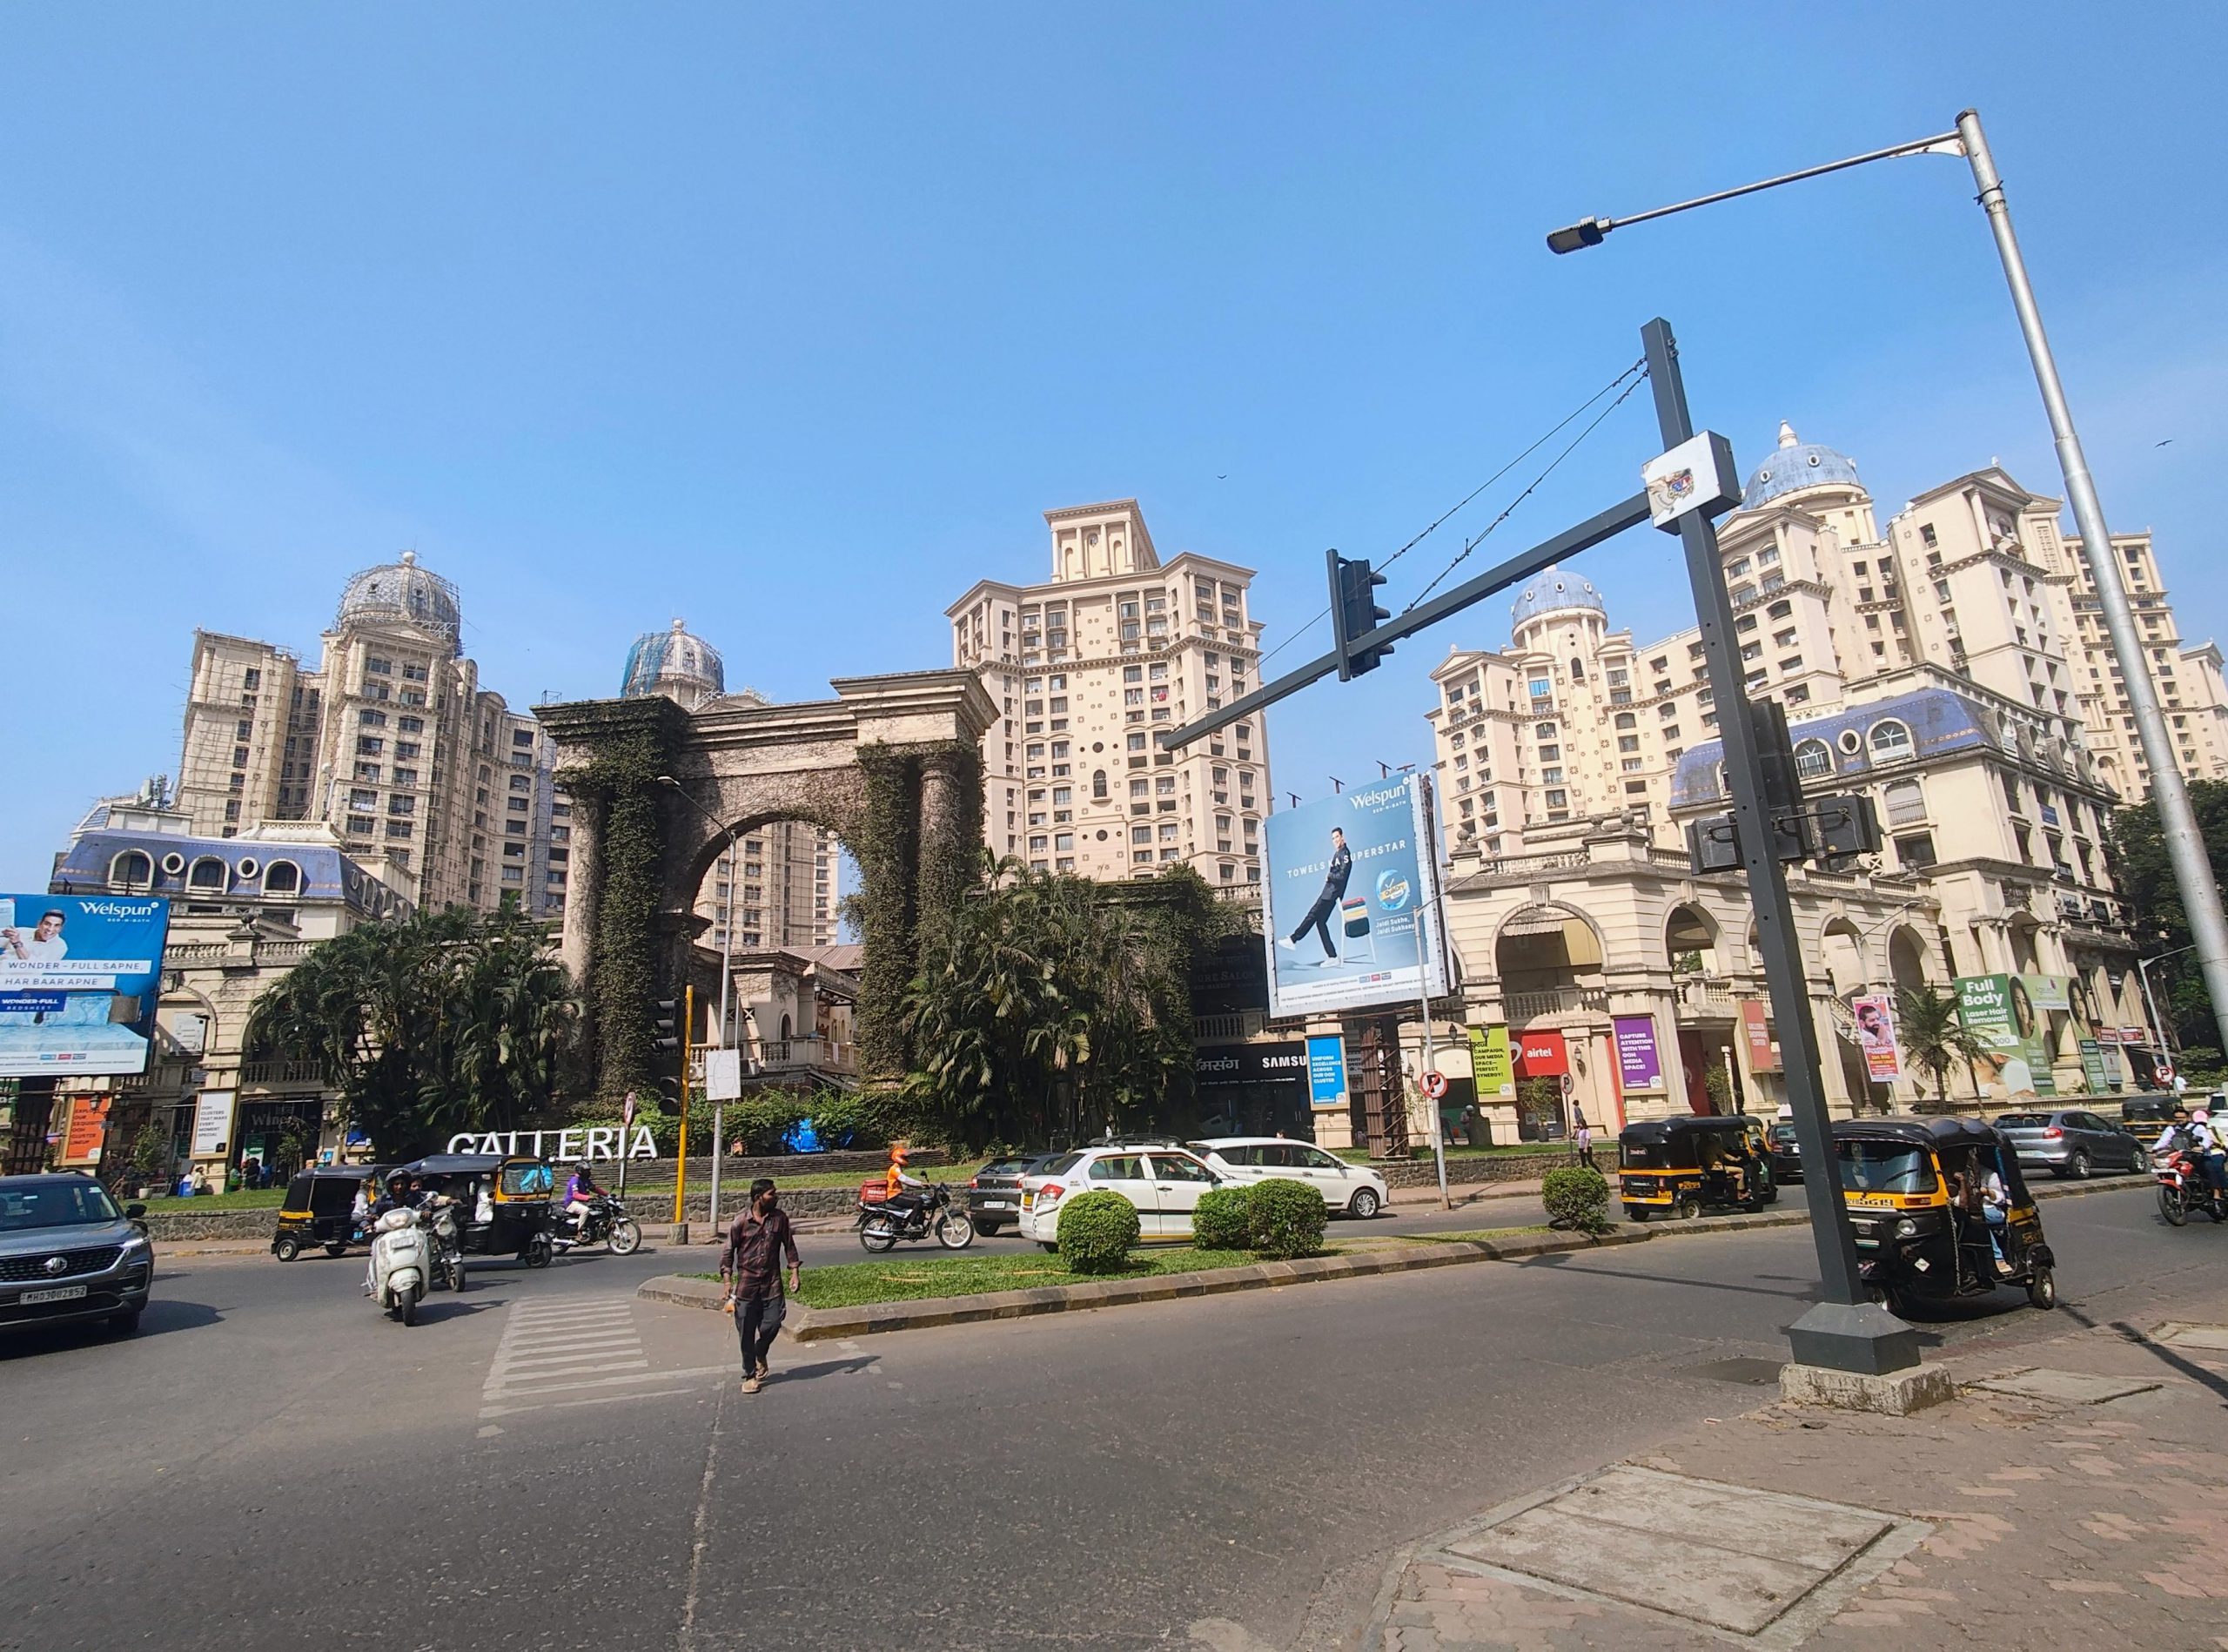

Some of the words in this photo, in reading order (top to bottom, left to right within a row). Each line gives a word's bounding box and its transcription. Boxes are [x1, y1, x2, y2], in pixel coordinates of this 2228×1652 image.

[1349, 785, 1406, 809] Welspun
[1287, 862, 1325, 878] TOWELS
[1328, 856, 1340, 868] KA
[1343, 839, 1406, 863] SUPERSTAR
[78, 902, 152, 918] Welspun
[103, 962, 144, 971] SAPNE,
[1965, 978, 1995, 992] Full
[1963, 992, 2003, 1007] Body
[1527, 1048, 1553, 1058] airtel
[1262, 1055, 1306, 1069] SAMSU
[447, 1125, 658, 1162] GALLERIA
